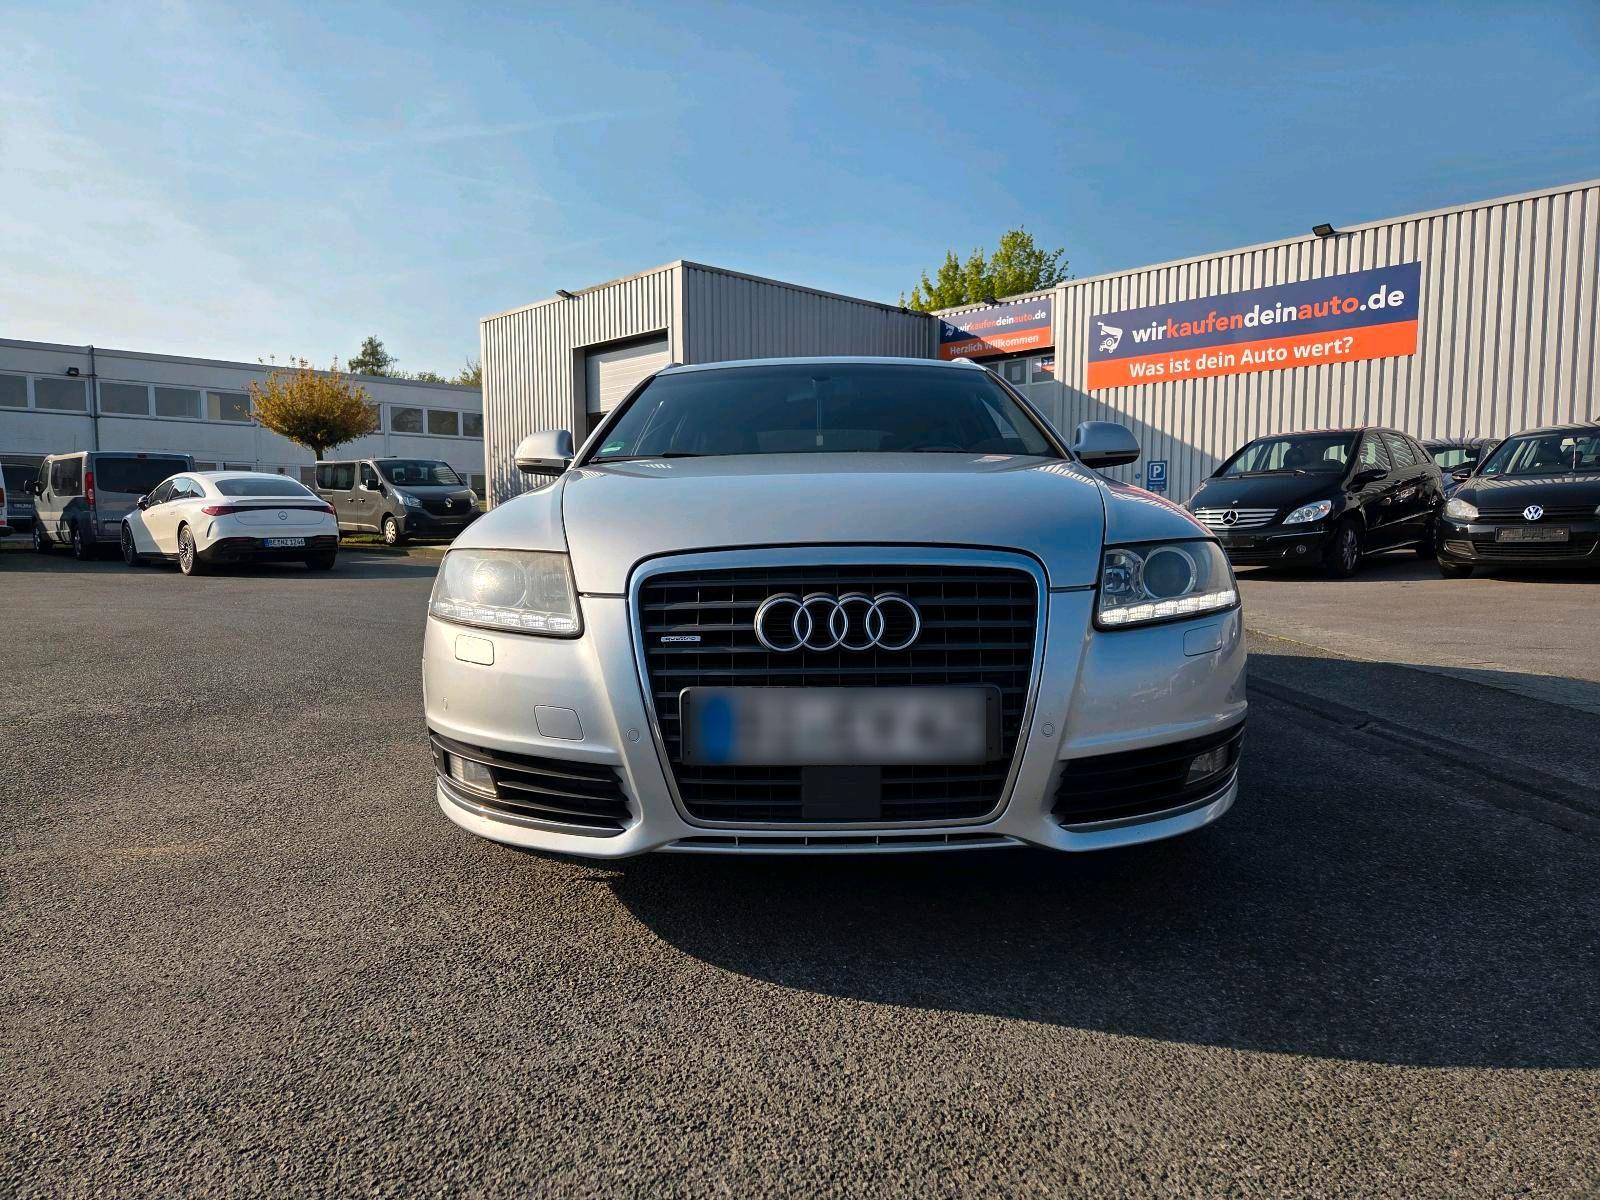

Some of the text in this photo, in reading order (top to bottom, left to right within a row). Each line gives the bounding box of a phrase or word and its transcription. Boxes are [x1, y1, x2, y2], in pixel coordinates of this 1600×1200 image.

[1132, 284, 1405, 344] wirkaufendeinauto.de
[950, 335, 1039, 355] Herzlich Willkommen
[1129, 336, 1354, 378] Was ist dein Auto wert?
[1152, 465, 1162, 478] P
